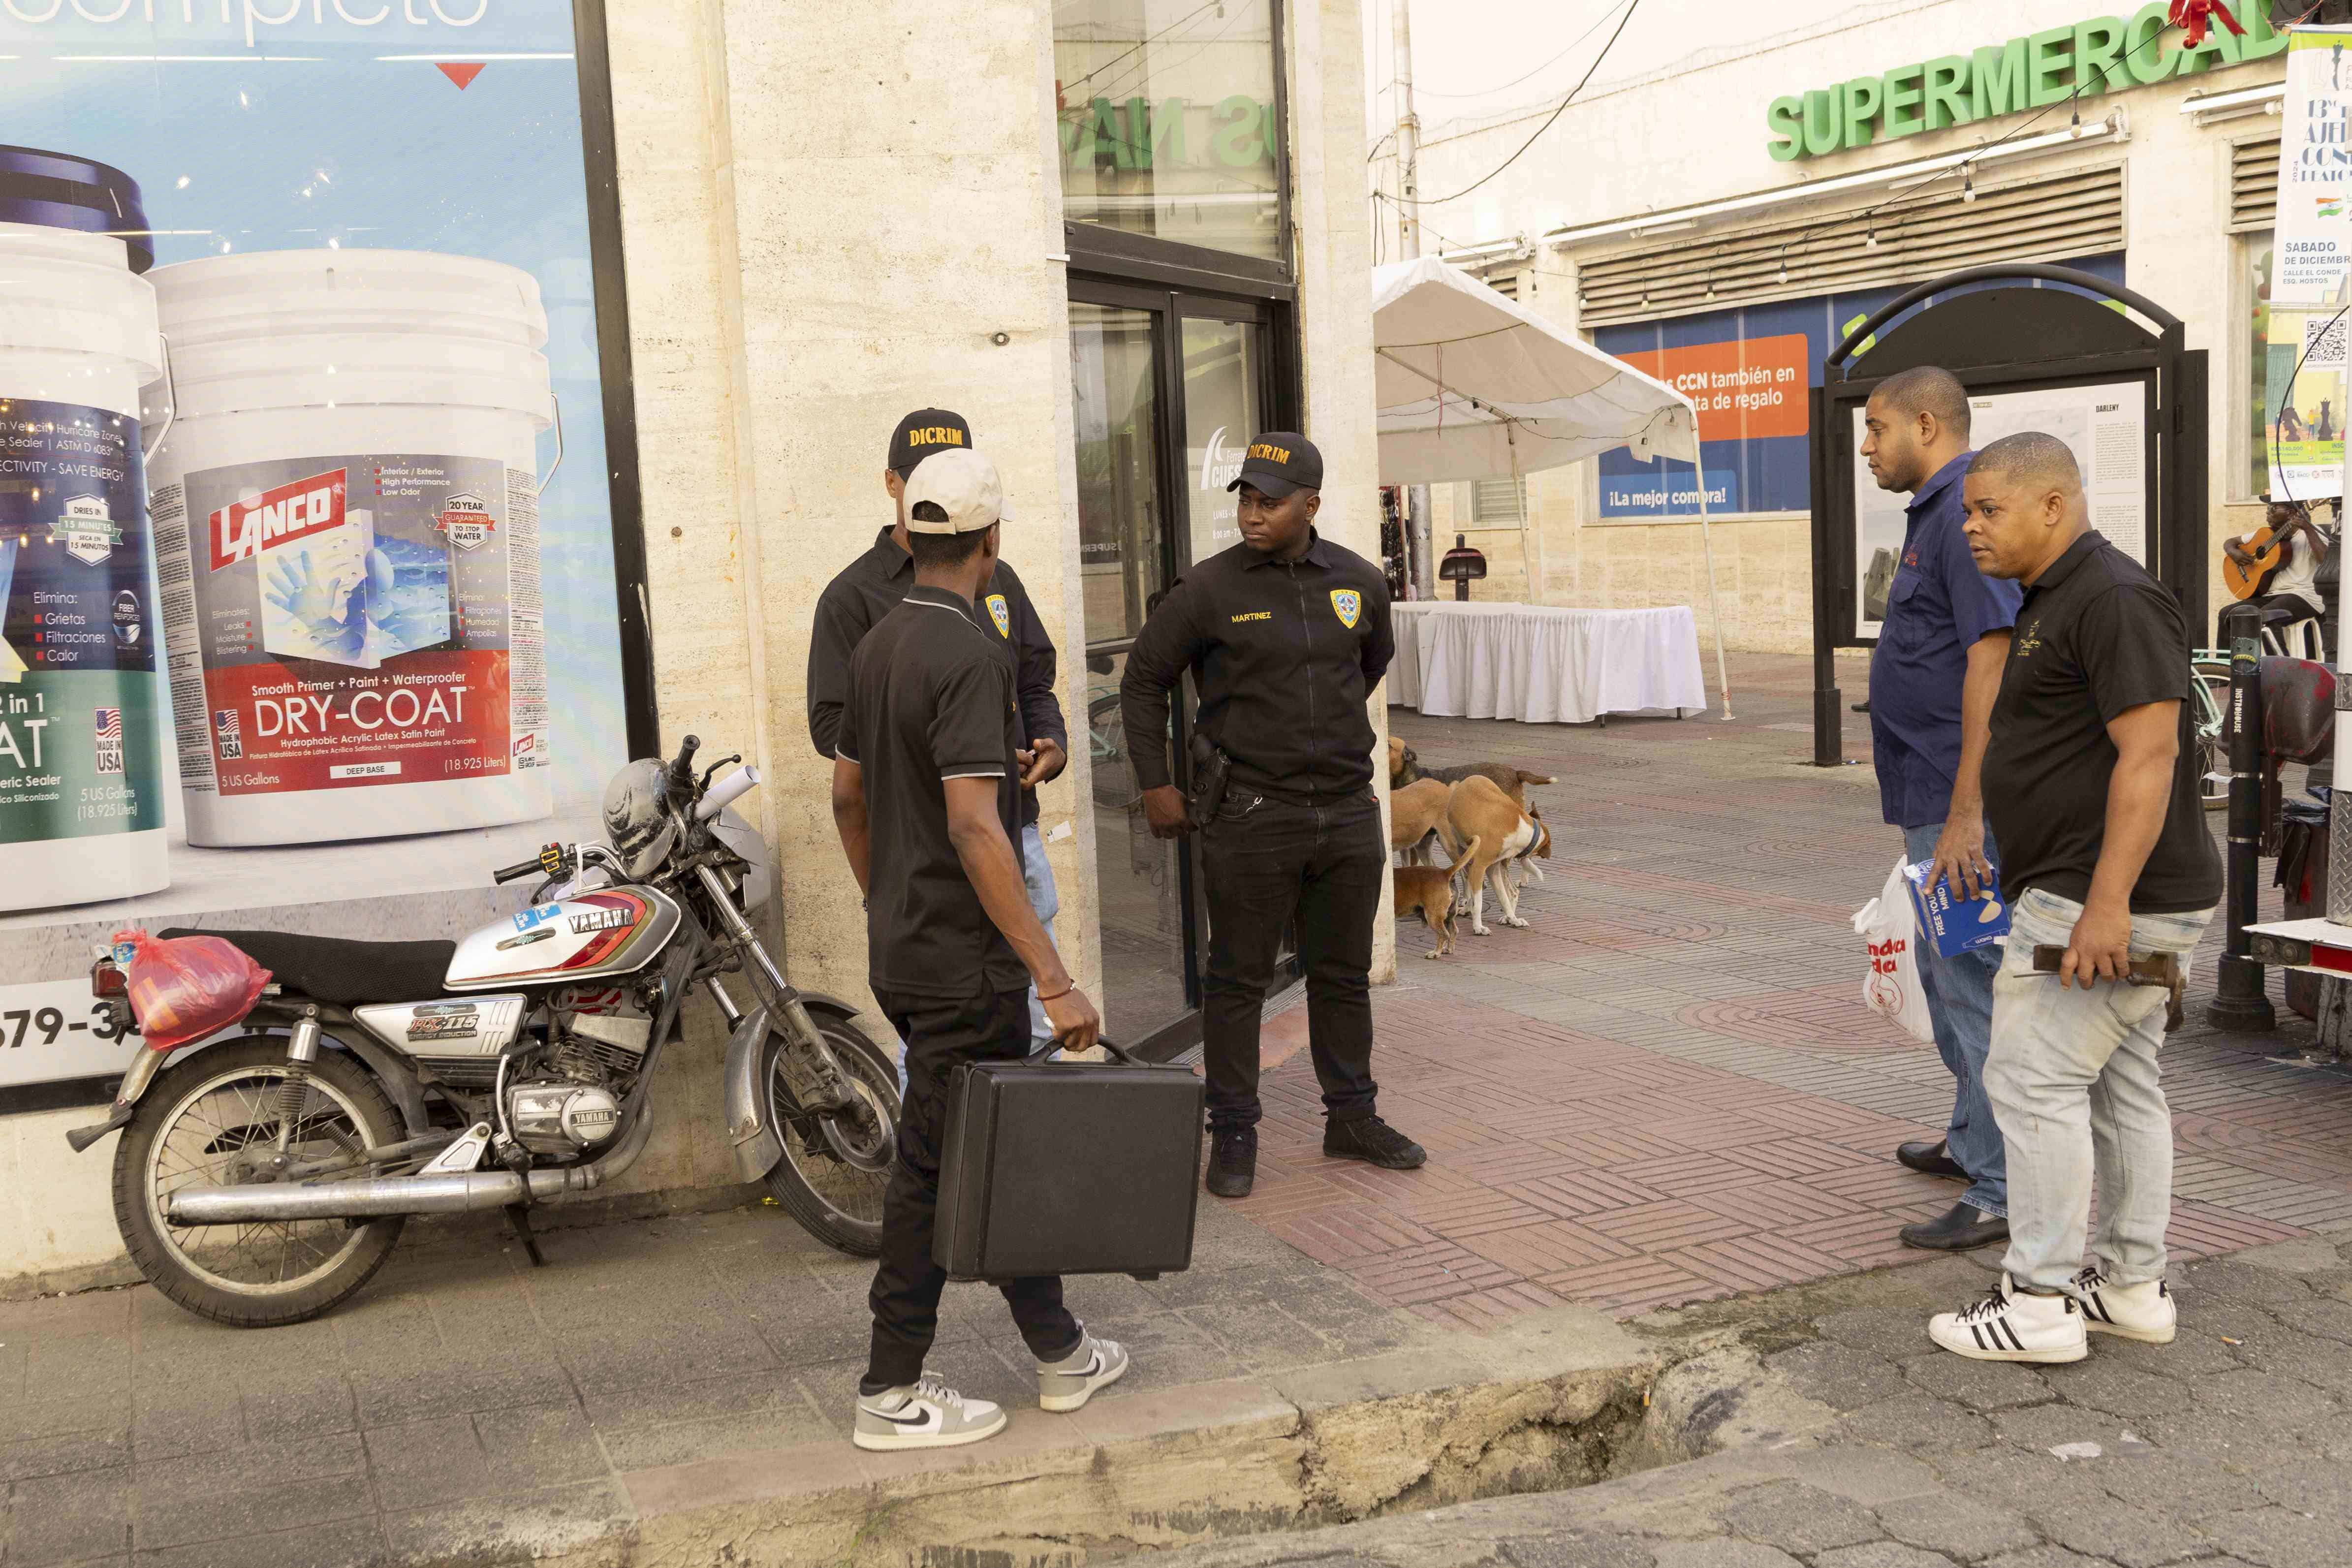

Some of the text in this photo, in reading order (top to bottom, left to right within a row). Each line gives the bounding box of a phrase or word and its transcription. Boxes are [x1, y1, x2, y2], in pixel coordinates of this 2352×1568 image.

[2286, 242, 2336, 252] SABADO
[2285, 256, 2296, 265] DE
[1677, 373, 1708, 391] CCN
[1711, 366, 1771, 389] también
[1776, 367, 1795, 382] en
[1713, 392, 1731, 410] de
[1735, 388, 1783, 410] regalo
[2096, 404, 2119, 413] DARLENY
[909, 427, 963, 446] DICRIM
[9, 437, 43, 448] Sealer
[56, 440, 82, 451] ASTM
[84, 443, 91, 452] D
[1248, 444, 1290, 465] DICRIM
[59, 463, 87, 476] SAVE
[90, 466, 124, 482] ENERGY
[381, 467, 409, 476] Interior
[1610, 491, 1629, 506] ¡La
[1632, 490, 1668, 508] mejor
[74, 506, 93, 515] DRIES
[449, 501, 483, 511] 20 YEAR
[444, 514, 488, 523] GUARANTEED
[1213, 509, 1228, 520] LUNES
[78, 521, 111, 532] MINUTES
[454, 532, 481, 540] WATER
[81, 542, 109, 551] MINUTOS
[33, 592, 78, 604] Elimina:
[45, 612, 86, 625] Grietas
[212, 608, 250, 619] Eliminates:
[1231, 612, 1271, 623] MARTINEZ
[224, 622, 245, 630] Leaks
[46, 631, 106, 643] Filtraciones
[216, 634, 246, 643] Moisture
[47, 650, 79, 661] Calor
[217, 645, 247, 655] Blistering
[251, 682, 294, 696] Smooth
[297, 679, 335, 693] Primer
[349, 675, 378, 688] Paint
[393, 672, 466, 686] Waterproofer
[9, 693, 43, 714] in 1
[2234, 688, 2243, 733] INSTROHOUSE
[220, 734, 233, 742] MADE
[281, 728, 445, 749] Hydrophobic Acrylic Latex Satin Paint
[97, 740, 122, 751] MADE IN
[220, 743, 241, 758] USA
[388, 741, 442, 750] Impermeabilizante
[97, 752, 121, 771] USA
[444, 757, 482, 773] (18.925
[484, 755, 506, 768] Liters)
[25, 774, 61, 787] Sealer
[222, 772, 280, 787] 5 US Gallons
[14, 793, 60, 803] Siliconizado
[80, 786, 135, 802] 5 US Gallons
[77, 804, 116, 821] (18.925
[1938, 887, 1949, 910] MIND
[568, 909, 633, 933] YAMAHA
[1933, 914, 1945, 936] FREE
[575, 1112, 609, 1123] YAMAHA
